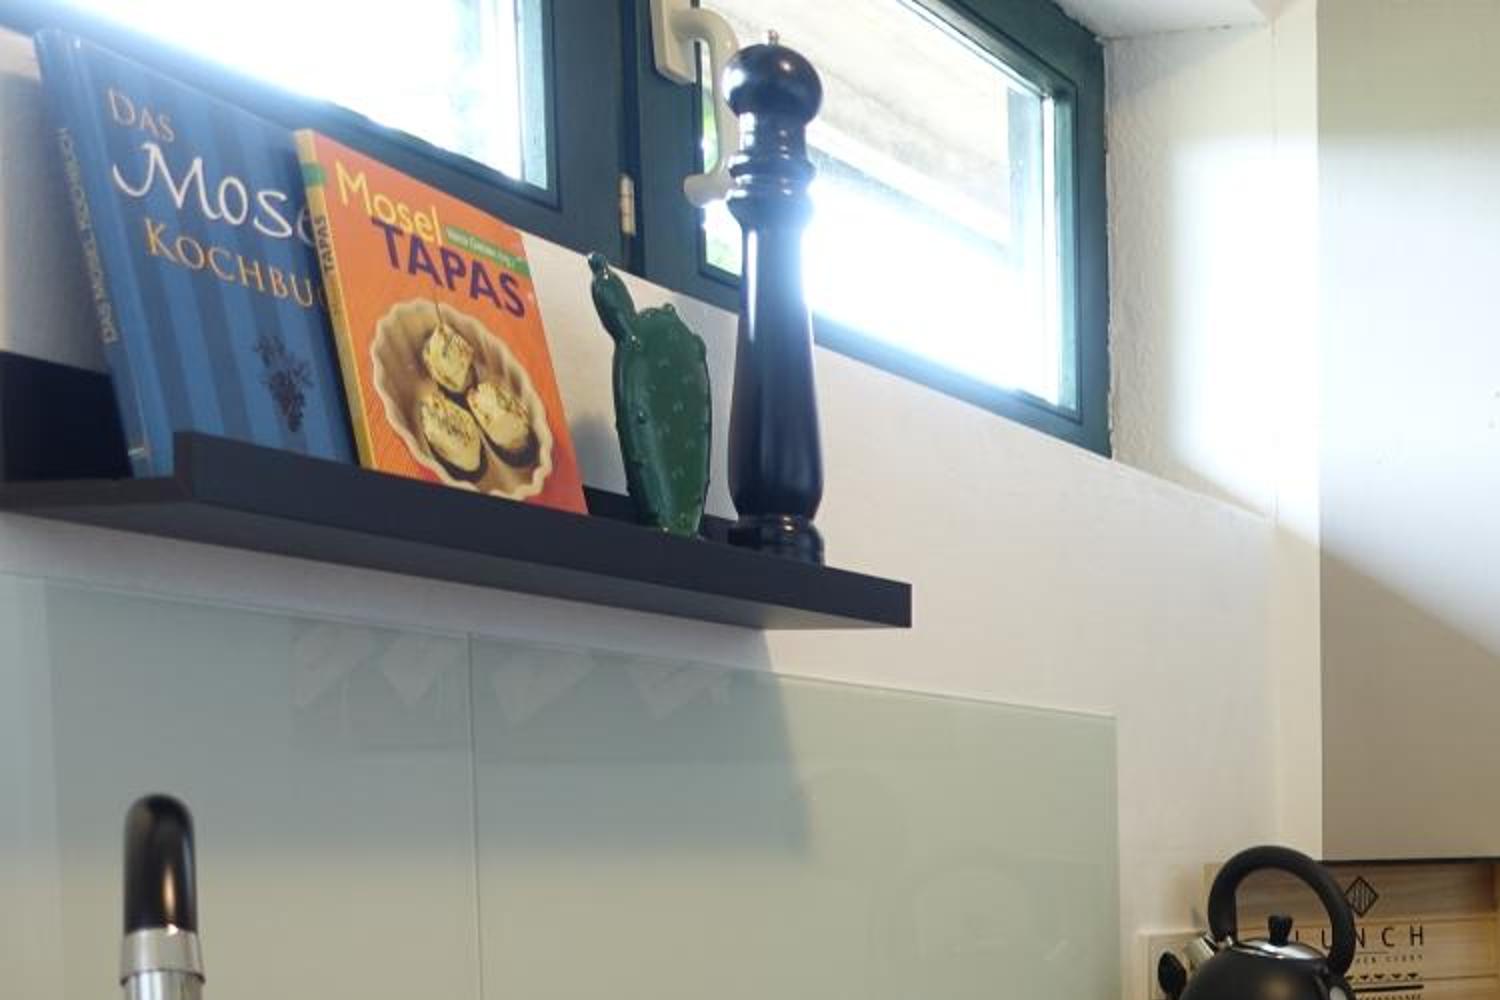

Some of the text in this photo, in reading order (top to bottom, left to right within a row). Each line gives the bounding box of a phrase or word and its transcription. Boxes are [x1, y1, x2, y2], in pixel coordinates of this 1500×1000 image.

[107, 87, 175, 143] DAS
[111, 141, 316, 249] Mos
[334, 159, 445, 248] Mosel
[145, 217, 314, 307] KOCHBU
[371, 216, 525, 319] TAPAS
